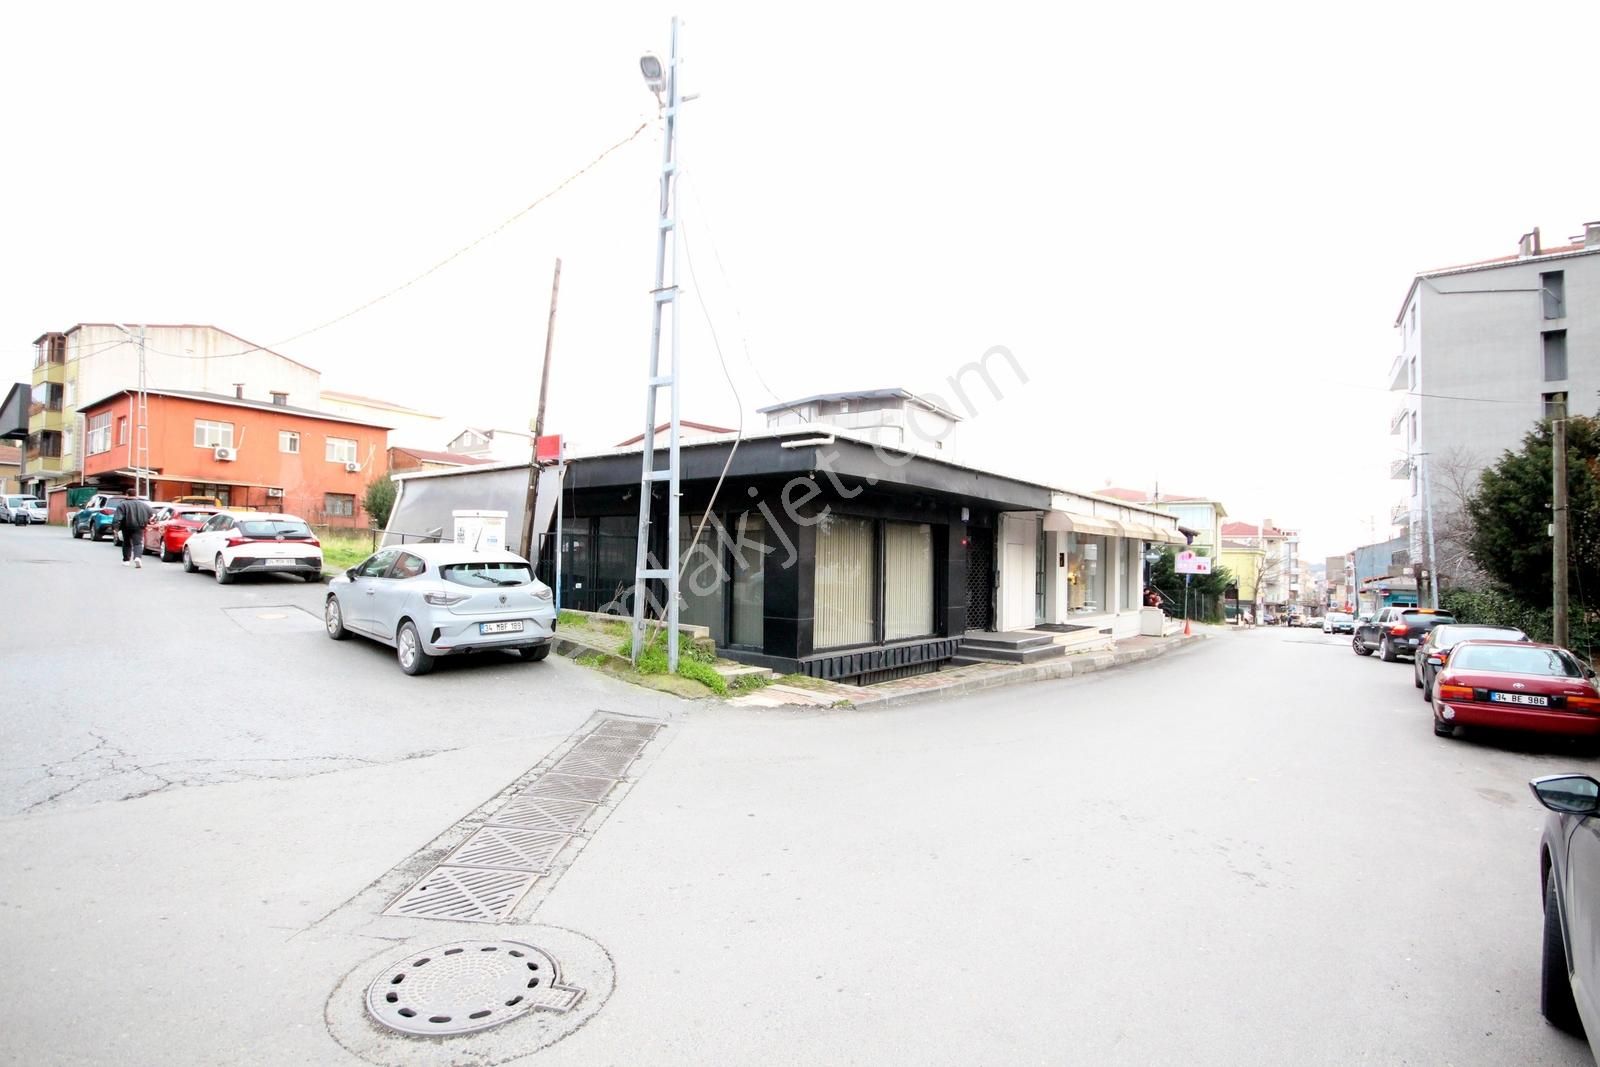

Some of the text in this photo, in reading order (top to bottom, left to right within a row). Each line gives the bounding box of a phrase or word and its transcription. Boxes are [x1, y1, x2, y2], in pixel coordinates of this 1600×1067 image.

[484, 624, 493, 632] 34
[1496, 693, 1545, 705] 34 BE 986
